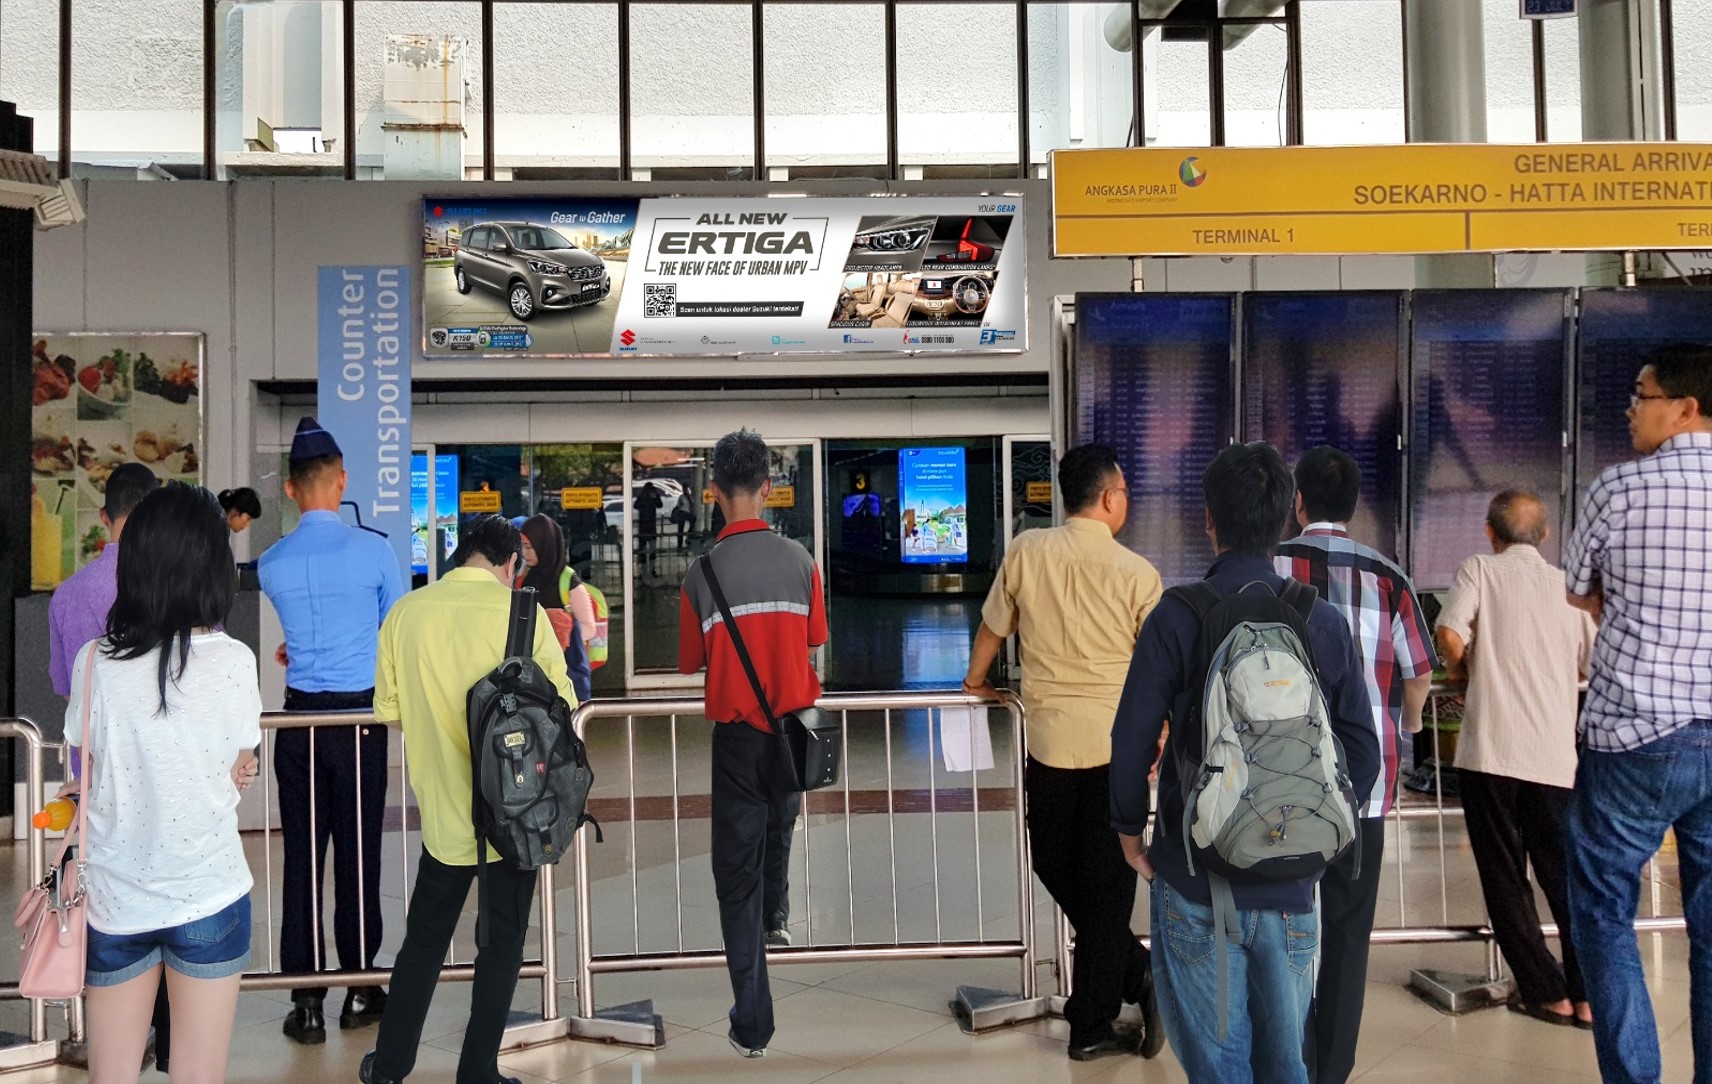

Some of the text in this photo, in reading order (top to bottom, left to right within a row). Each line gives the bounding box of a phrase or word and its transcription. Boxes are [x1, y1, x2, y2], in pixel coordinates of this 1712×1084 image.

[1514, 153, 1625, 174] GENERAL
[1085, 184, 1177, 196] ANGKASA PURA II
[1354, 184, 1487, 205] SOEKARNO
[1510, 182, 1586, 203] HATTA
[447, 207, 487, 216] SUZUKI
[996, 204, 1016, 213] GEAR
[550, 211, 578, 224] Gear
[587, 211, 626, 224] Gather
[696, 213, 788, 225] ALL NEW
[1192, 228, 1294, 244] TERMINAL 1
[1677, 222, 1712, 236] TER
[658, 231, 814, 254] ERTIGA
[658, 260, 808, 276] THE NEW FACE OF URBAN MPV
[337, 269, 365, 401] Counter
[370, 268, 407, 517] Transportation
[856, 473, 866, 490] 3
